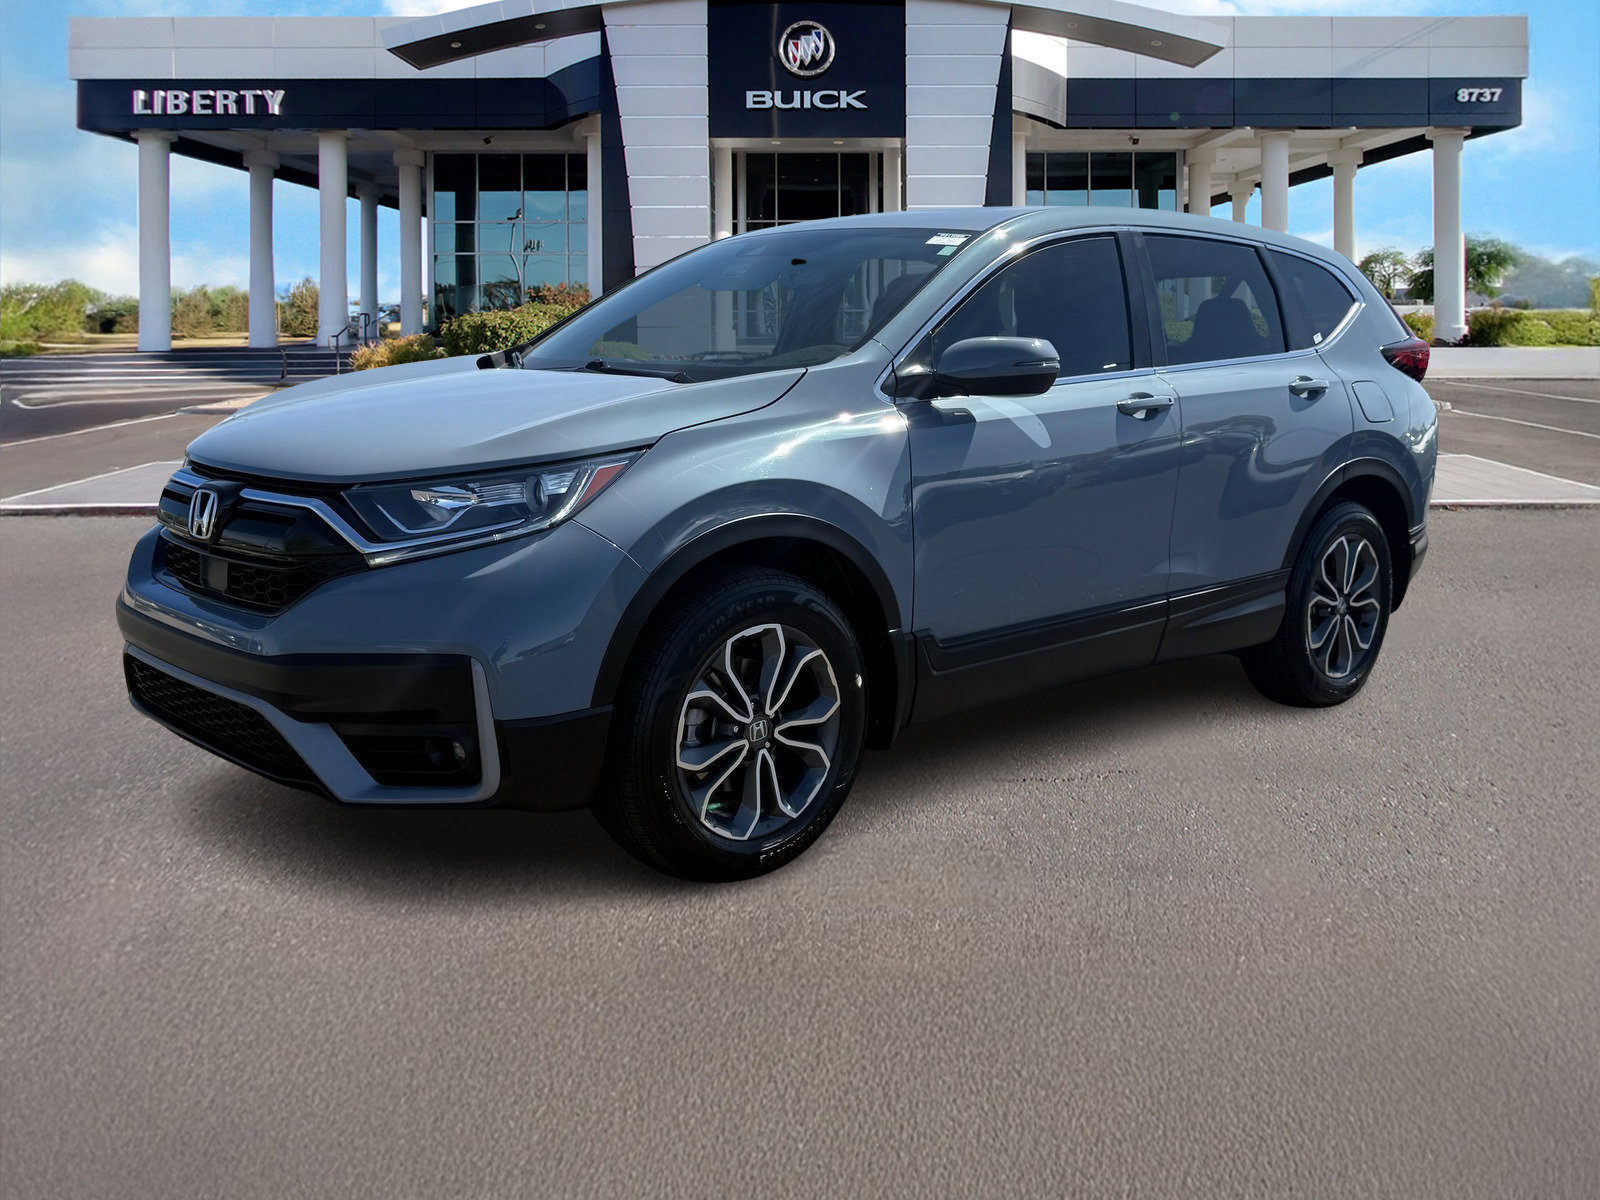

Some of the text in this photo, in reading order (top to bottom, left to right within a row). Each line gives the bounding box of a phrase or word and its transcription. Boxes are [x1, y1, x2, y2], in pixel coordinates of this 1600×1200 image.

[132, 89, 286, 115] LIBERTY
[745, 90, 868, 109] BUICK
[1456, 88, 1503, 103] 8737
